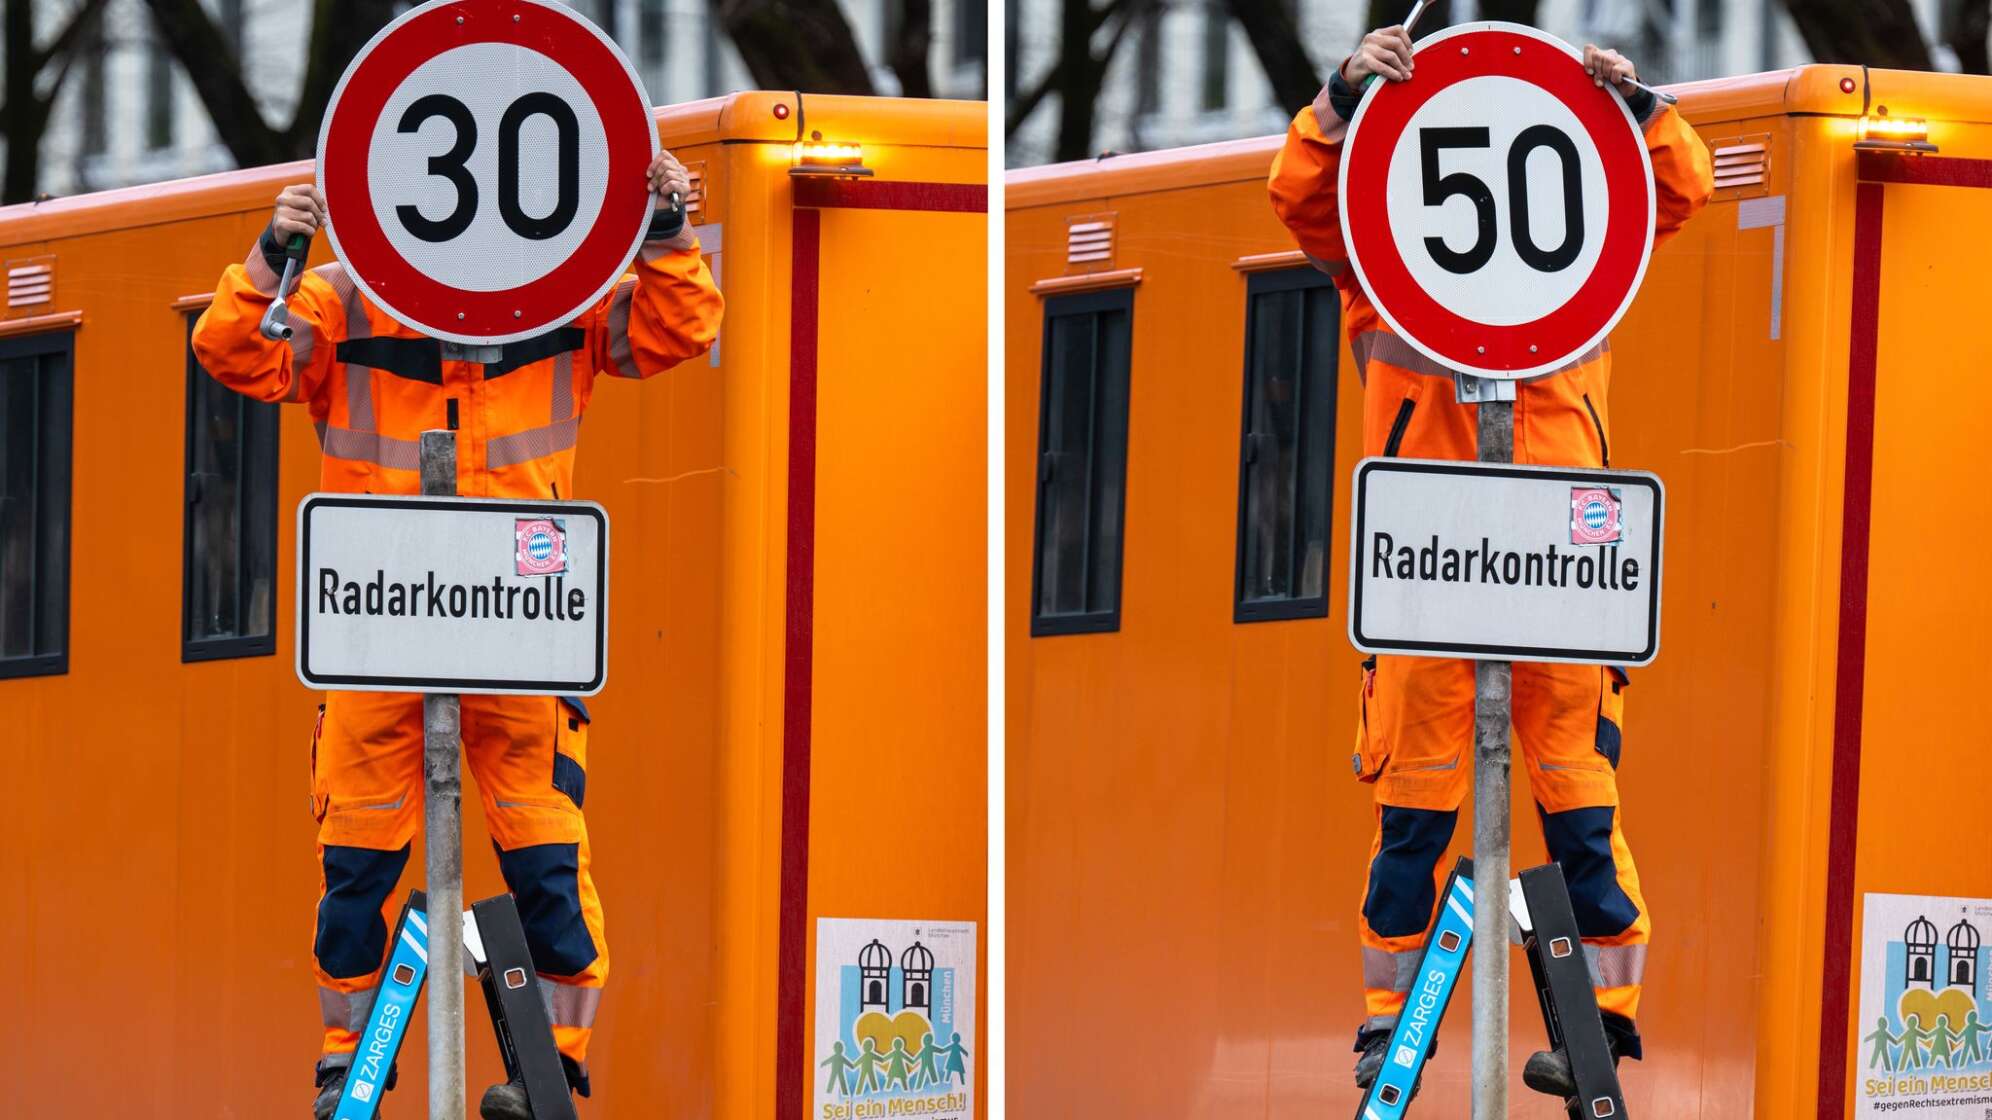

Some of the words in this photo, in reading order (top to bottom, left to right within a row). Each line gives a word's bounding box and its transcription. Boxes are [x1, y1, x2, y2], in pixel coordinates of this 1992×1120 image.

[396, 91, 580, 243] 30
[1419, 124, 1585, 274] 50
[1372, 532, 1640, 592] Radarkontrolle
[319, 567, 586, 622] Radarkontrolle
[941, 970, 953, 1024] München
[1403, 969, 1445, 1047] ZARGES
[360, 1002, 401, 1081] ZARGES
[823, 1100, 851, 1119] Sei
[855, 1098, 883, 1117] ein
[888, 1092, 965, 1114] Mensch!
[1865, 1075, 1894, 1096] Sei
[1897, 1074, 1926, 1094] ein
[1931, 1072, 1992, 1092] Mensc
